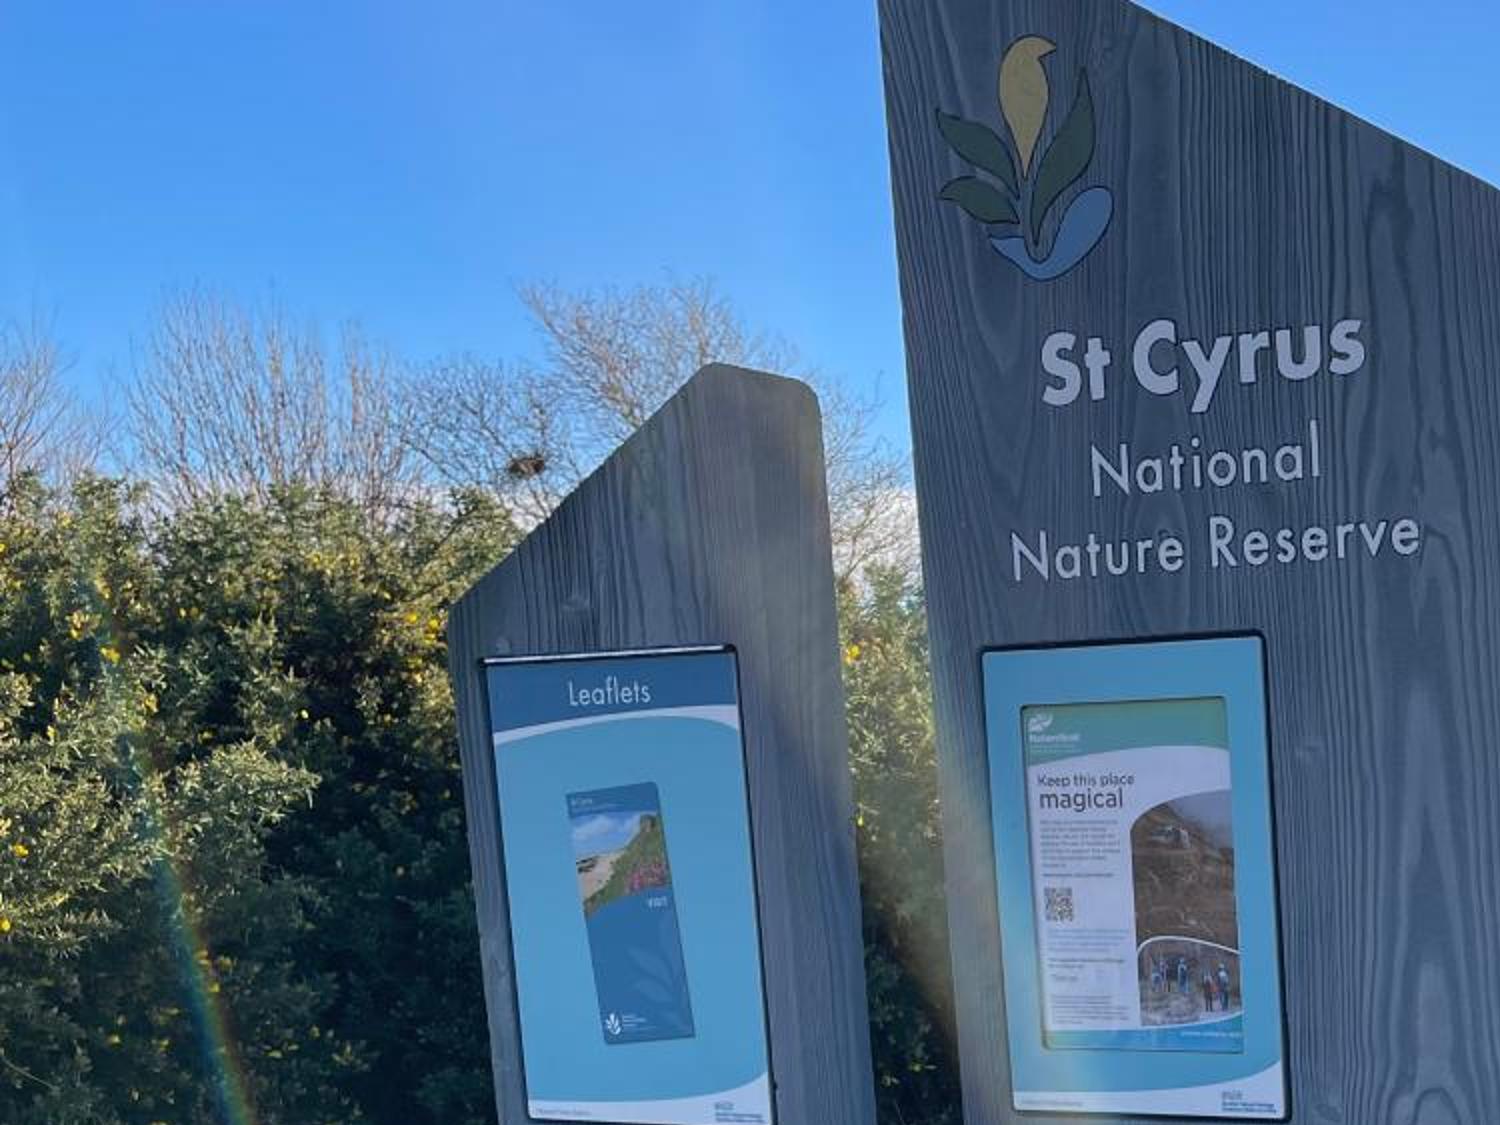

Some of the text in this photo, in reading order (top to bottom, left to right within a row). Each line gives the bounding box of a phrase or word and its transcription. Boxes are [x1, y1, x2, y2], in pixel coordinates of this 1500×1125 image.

[1041, 318, 1366, 413] St Cyrus
[1090, 418, 1320, 497] National
[1010, 514, 1420, 582] Nature Reserve
[567, 675, 651, 707] Leaflets
[1037, 772, 1135, 787] Keep this place
[1039, 787, 1123, 813] magical
